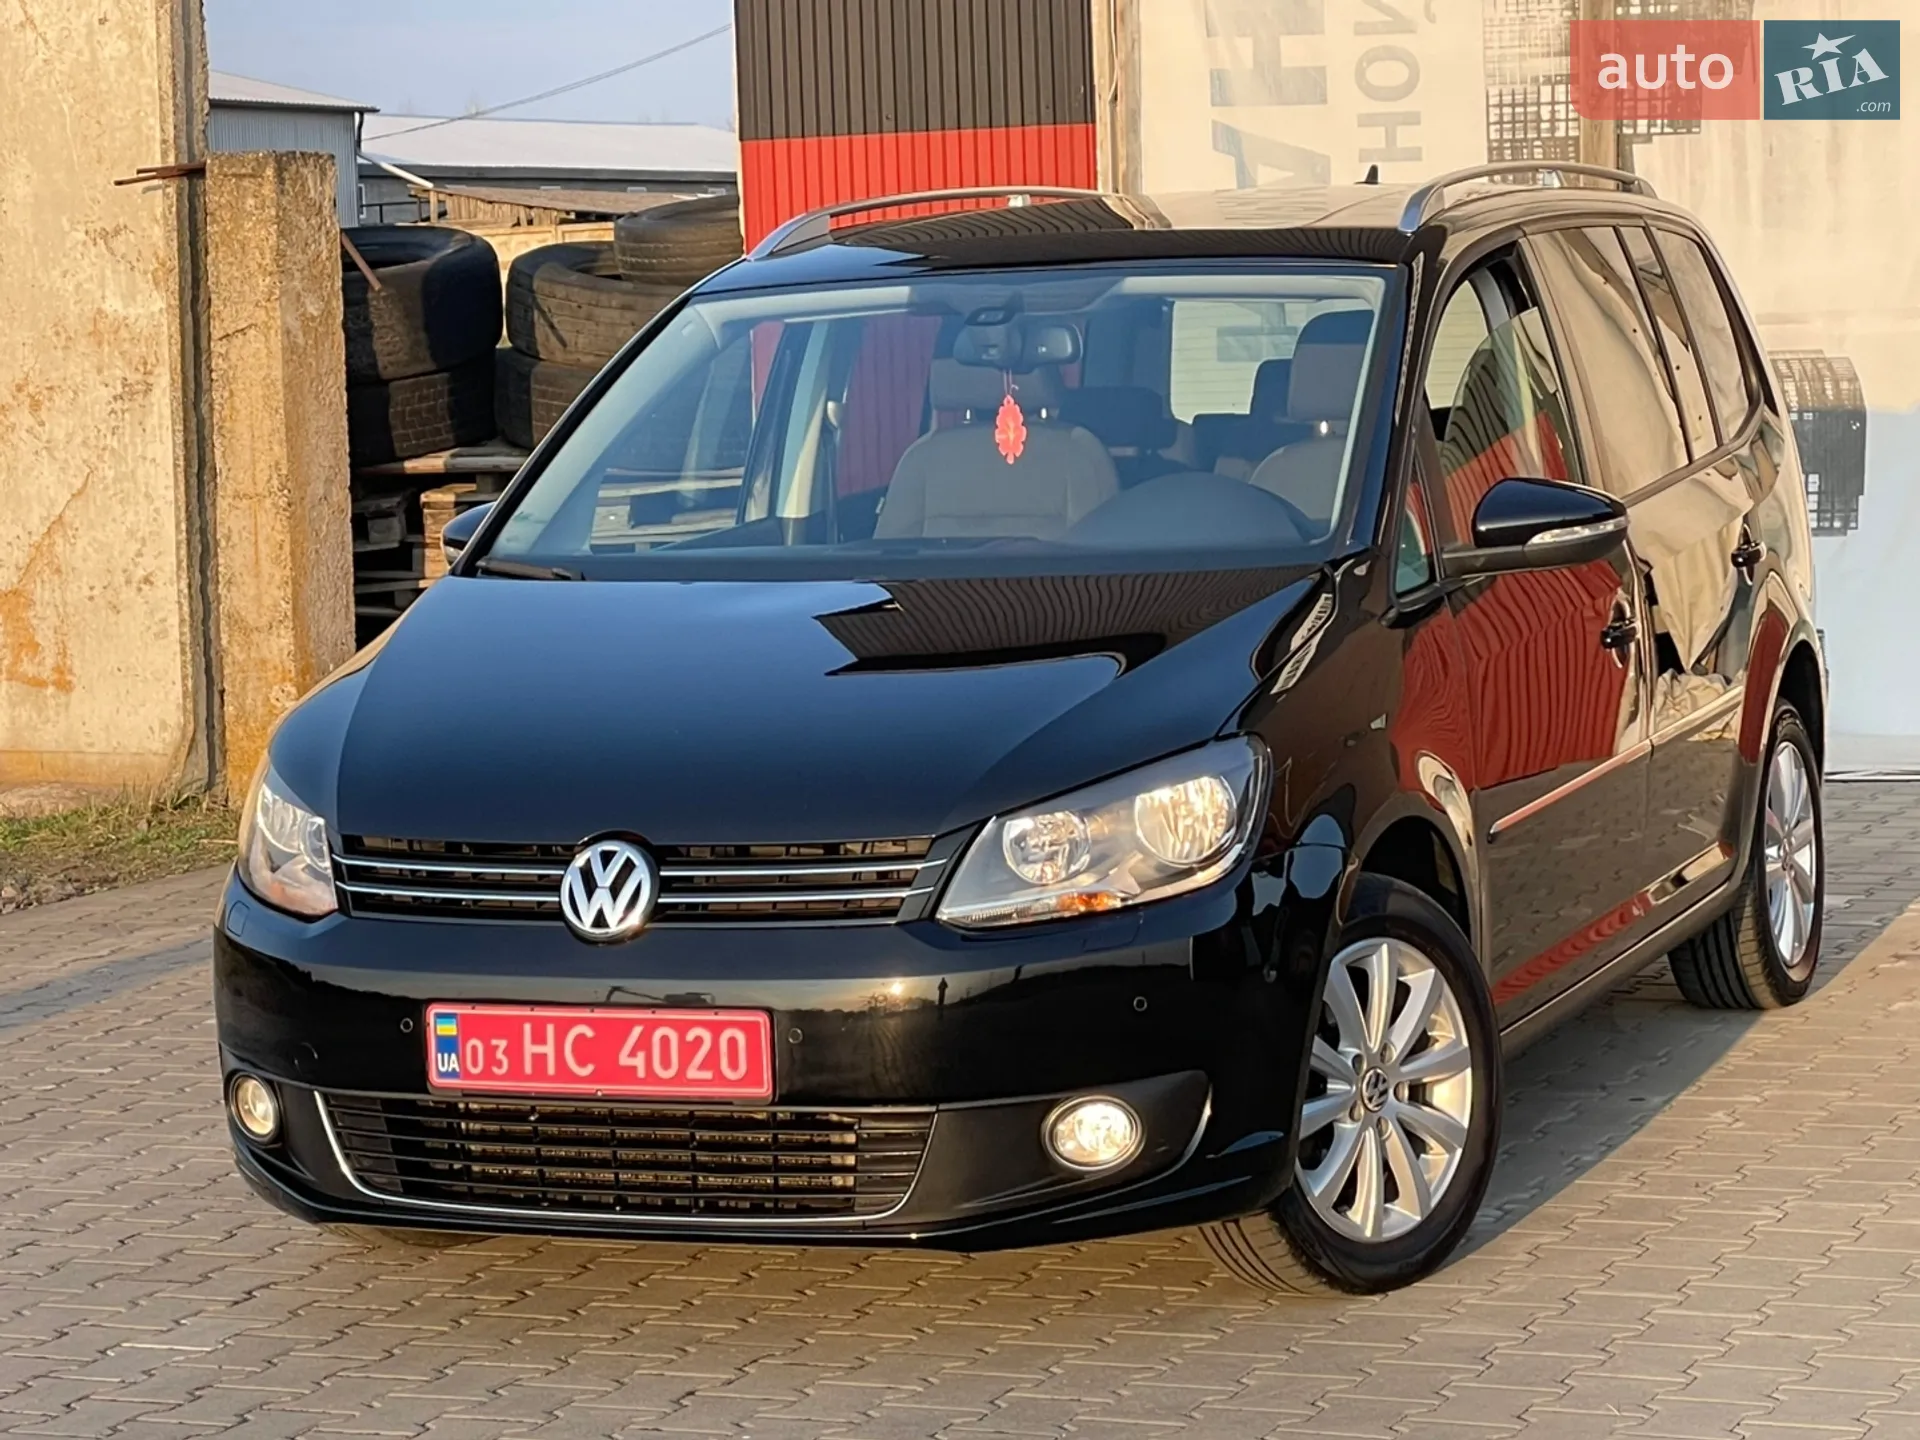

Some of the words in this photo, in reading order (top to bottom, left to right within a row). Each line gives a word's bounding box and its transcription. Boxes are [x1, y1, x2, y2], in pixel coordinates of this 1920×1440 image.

[437, 1053, 460, 1073] UA
[465, 1038, 509, 1076] 03
[523, 1022, 595, 1077] HC
[618, 1025, 748, 1081] 4020
